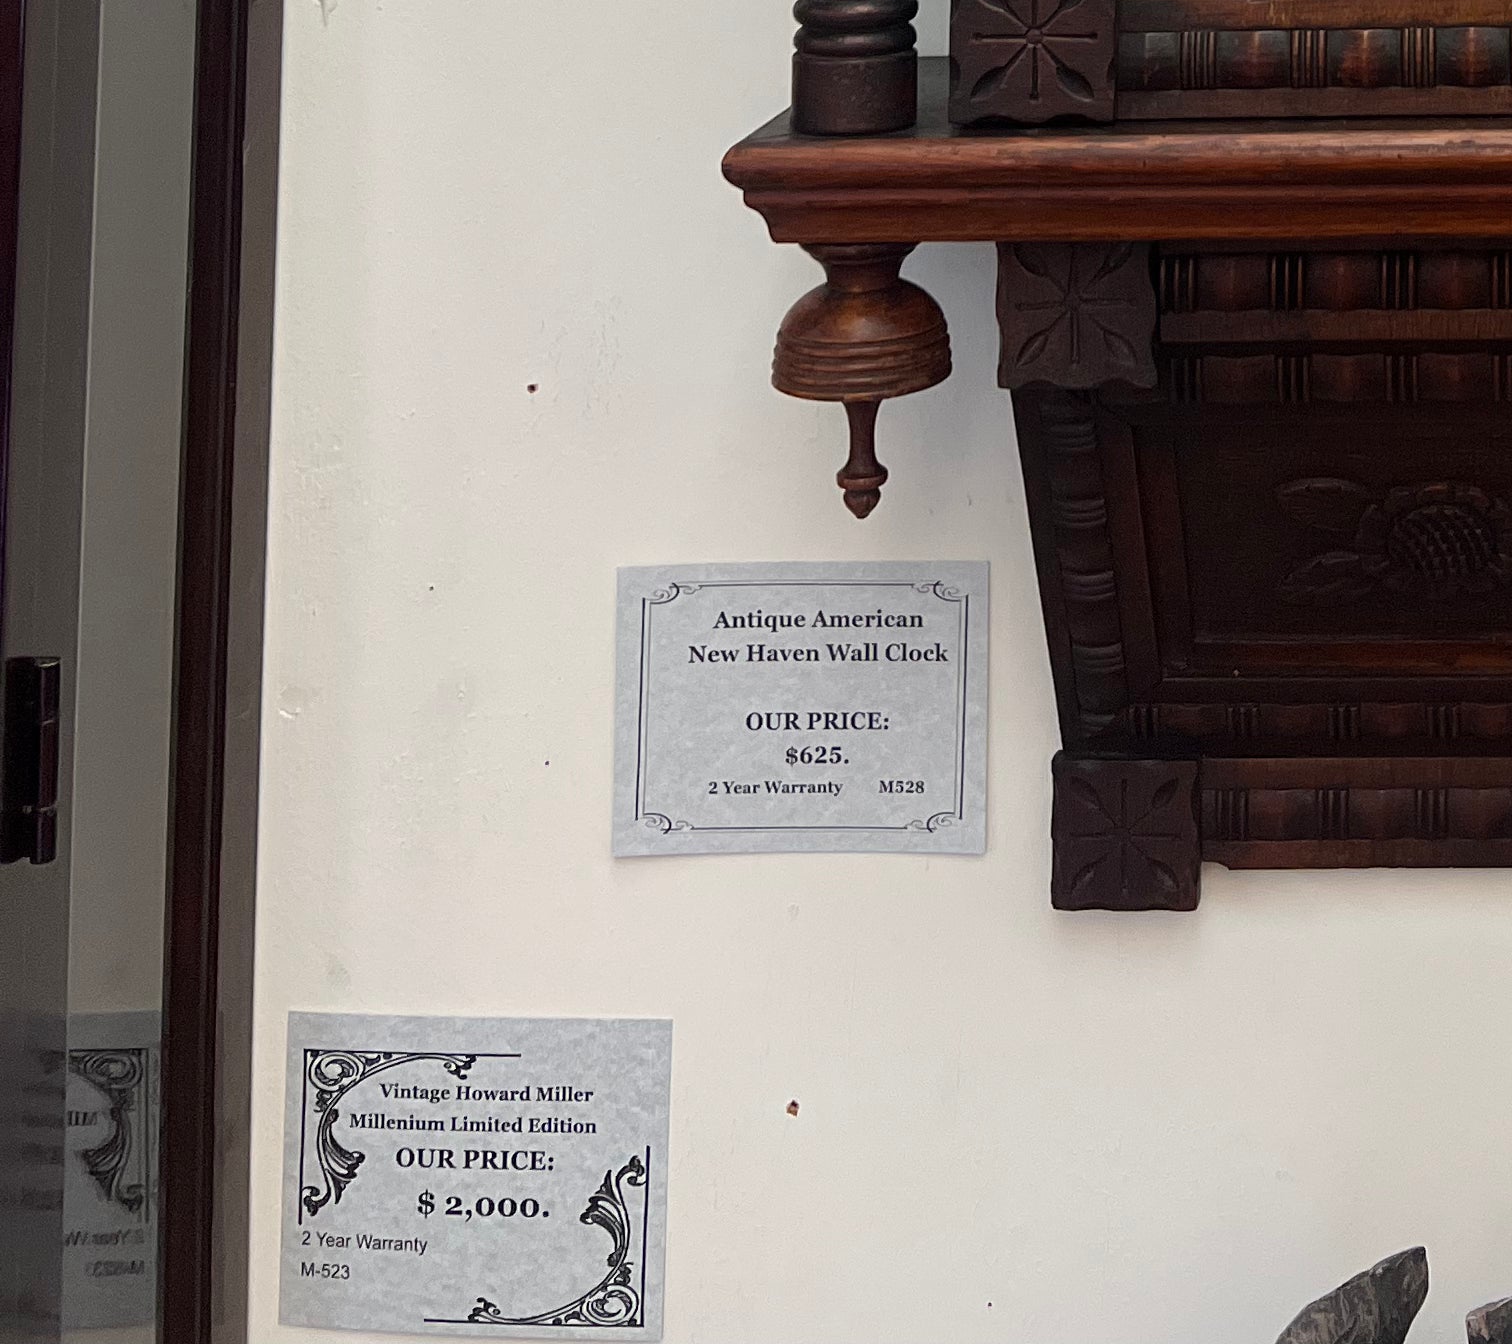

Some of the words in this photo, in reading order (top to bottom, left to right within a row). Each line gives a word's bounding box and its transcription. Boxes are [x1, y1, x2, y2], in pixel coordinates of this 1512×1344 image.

[713, 610, 805, 632] Antique
[812, 609, 923, 627] American
[689, 646, 739, 663] New
[747, 645, 819, 661] Haven
[826, 643, 878, 661] Wall
[886, 643, 948, 661] Clock
[746, 712, 800, 730] OUR
[808, 712, 888, 730] PRICE:
[786, 746, 848, 765] $625.
[709, 782, 717, 794] 2
[723, 781, 760, 794] Year
[765, 781, 841, 796] Warranty
[879, 781, 924, 793] M528
[380, 1083, 450, 1103] Vintage
[456, 1086, 531, 1101] Howard
[536, 1086, 593, 1102] Miller
[350, 1114, 444, 1131] Millenium
[451, 1116, 522, 1132] Limited
[529, 1118, 596, 1133] Edition
[396, 1148, 456, 1168] OUR
[463, 1150, 553, 1170] PRICE:
[302, 1231, 310, 1245] 2
[317, 1232, 351, 1247] Year
[356, 1234, 427, 1256] Warranty
[301, 1262, 349, 1279] M-523
